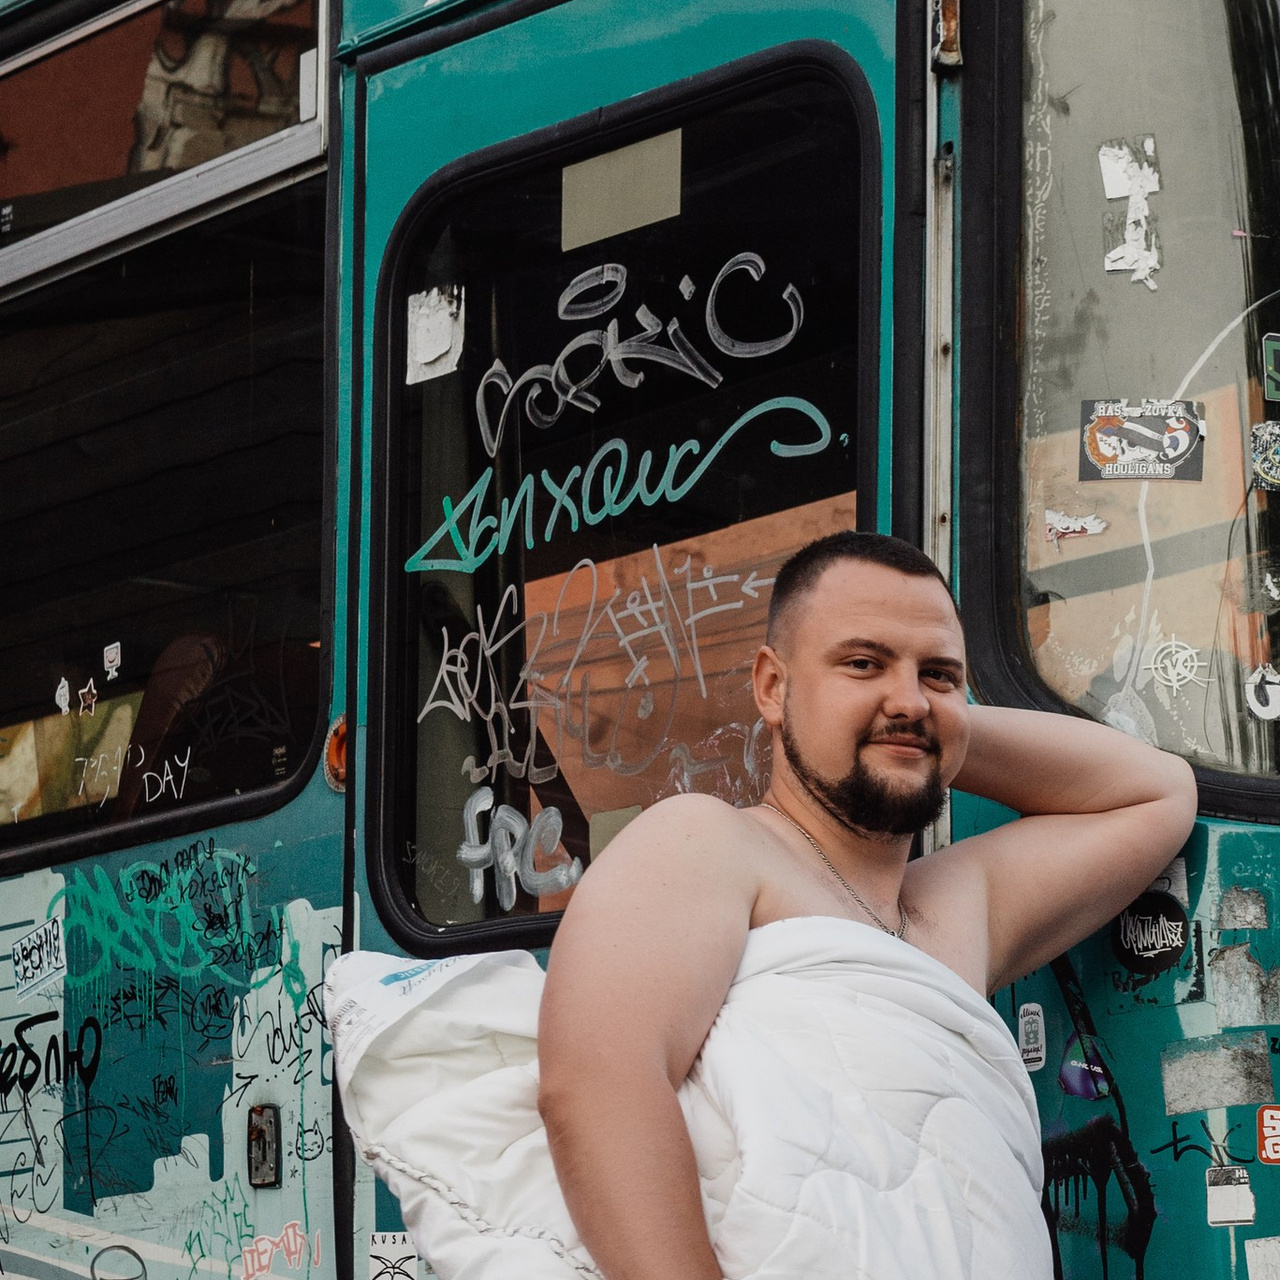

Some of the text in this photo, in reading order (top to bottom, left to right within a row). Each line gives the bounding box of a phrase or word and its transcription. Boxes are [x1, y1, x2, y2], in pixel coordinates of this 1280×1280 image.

[1105, 462, 1172, 475] HOULIGANS
[142, 745, 191, 803] DAY
[370, 1234, 415, 1246] KUSA
